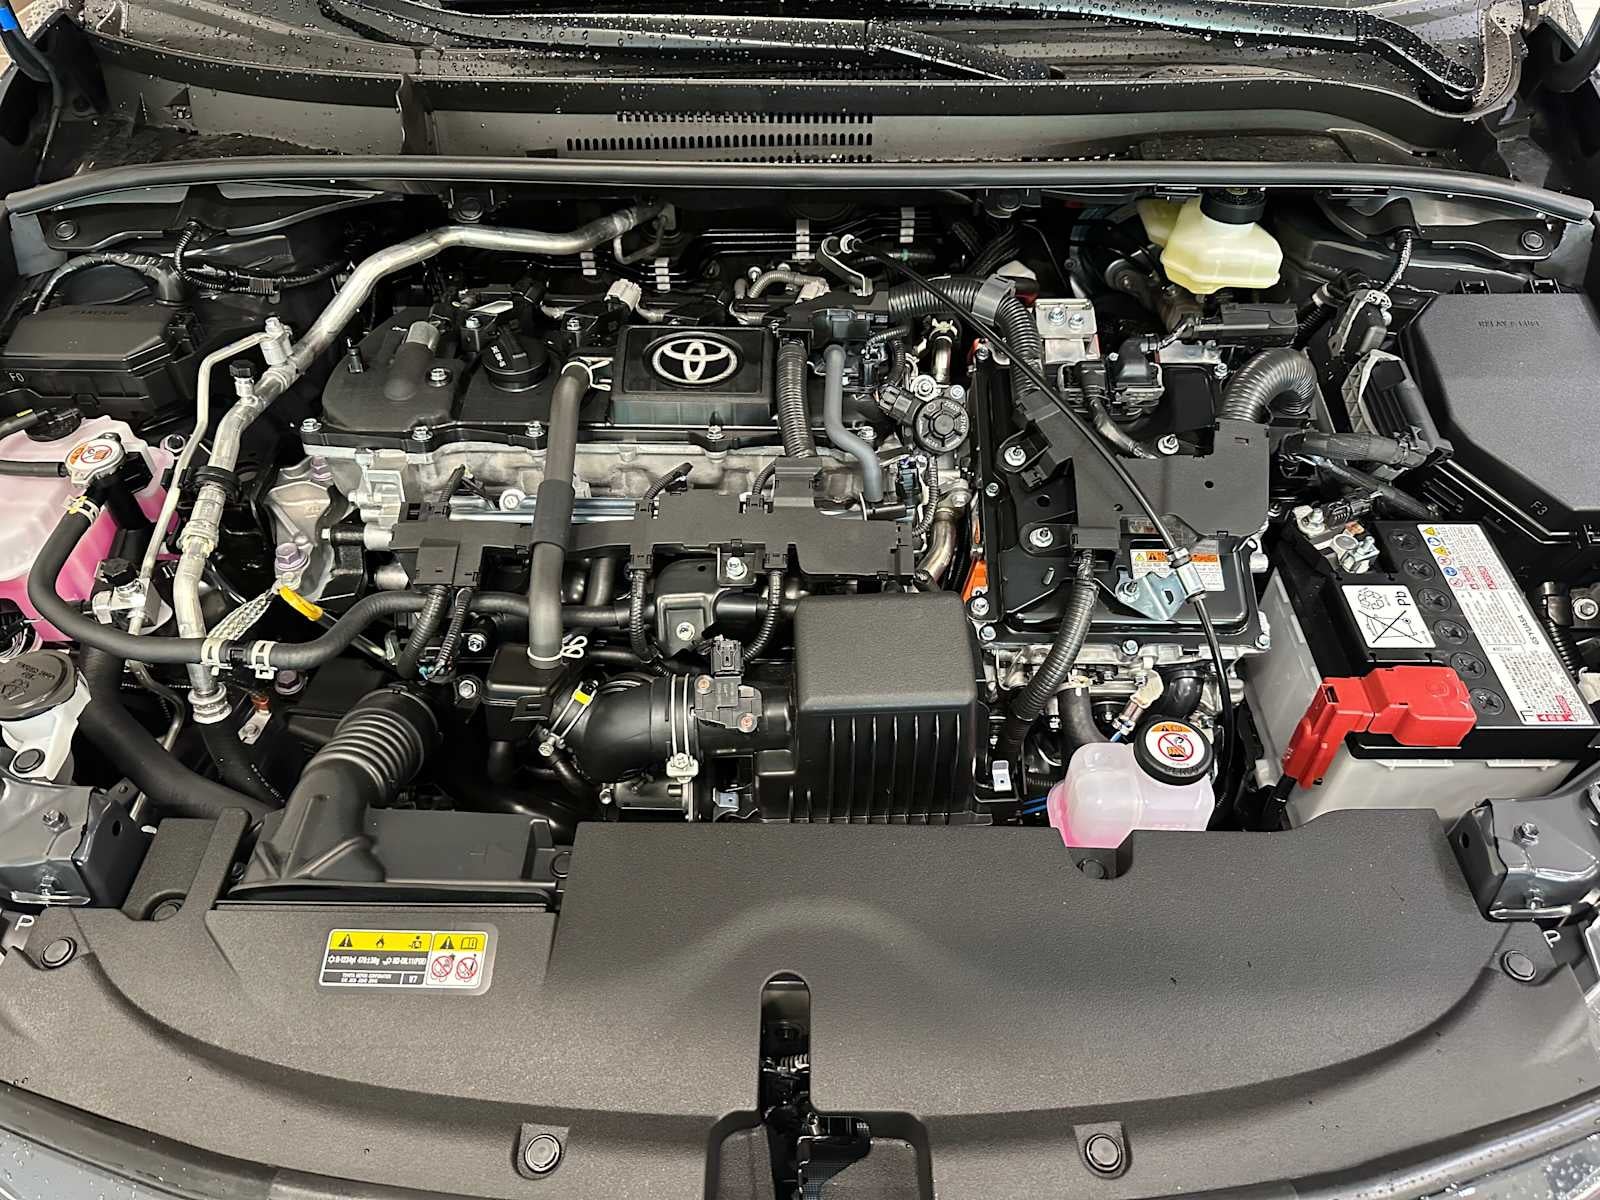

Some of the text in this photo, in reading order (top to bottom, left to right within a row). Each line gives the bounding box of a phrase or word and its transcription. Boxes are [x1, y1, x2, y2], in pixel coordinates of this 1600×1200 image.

[1530, 500, 1549, 516] F3
[1394, 591, 1411, 606] Pb
[14, 914, 35, 931] P
[1542, 929, 1561, 948] P
